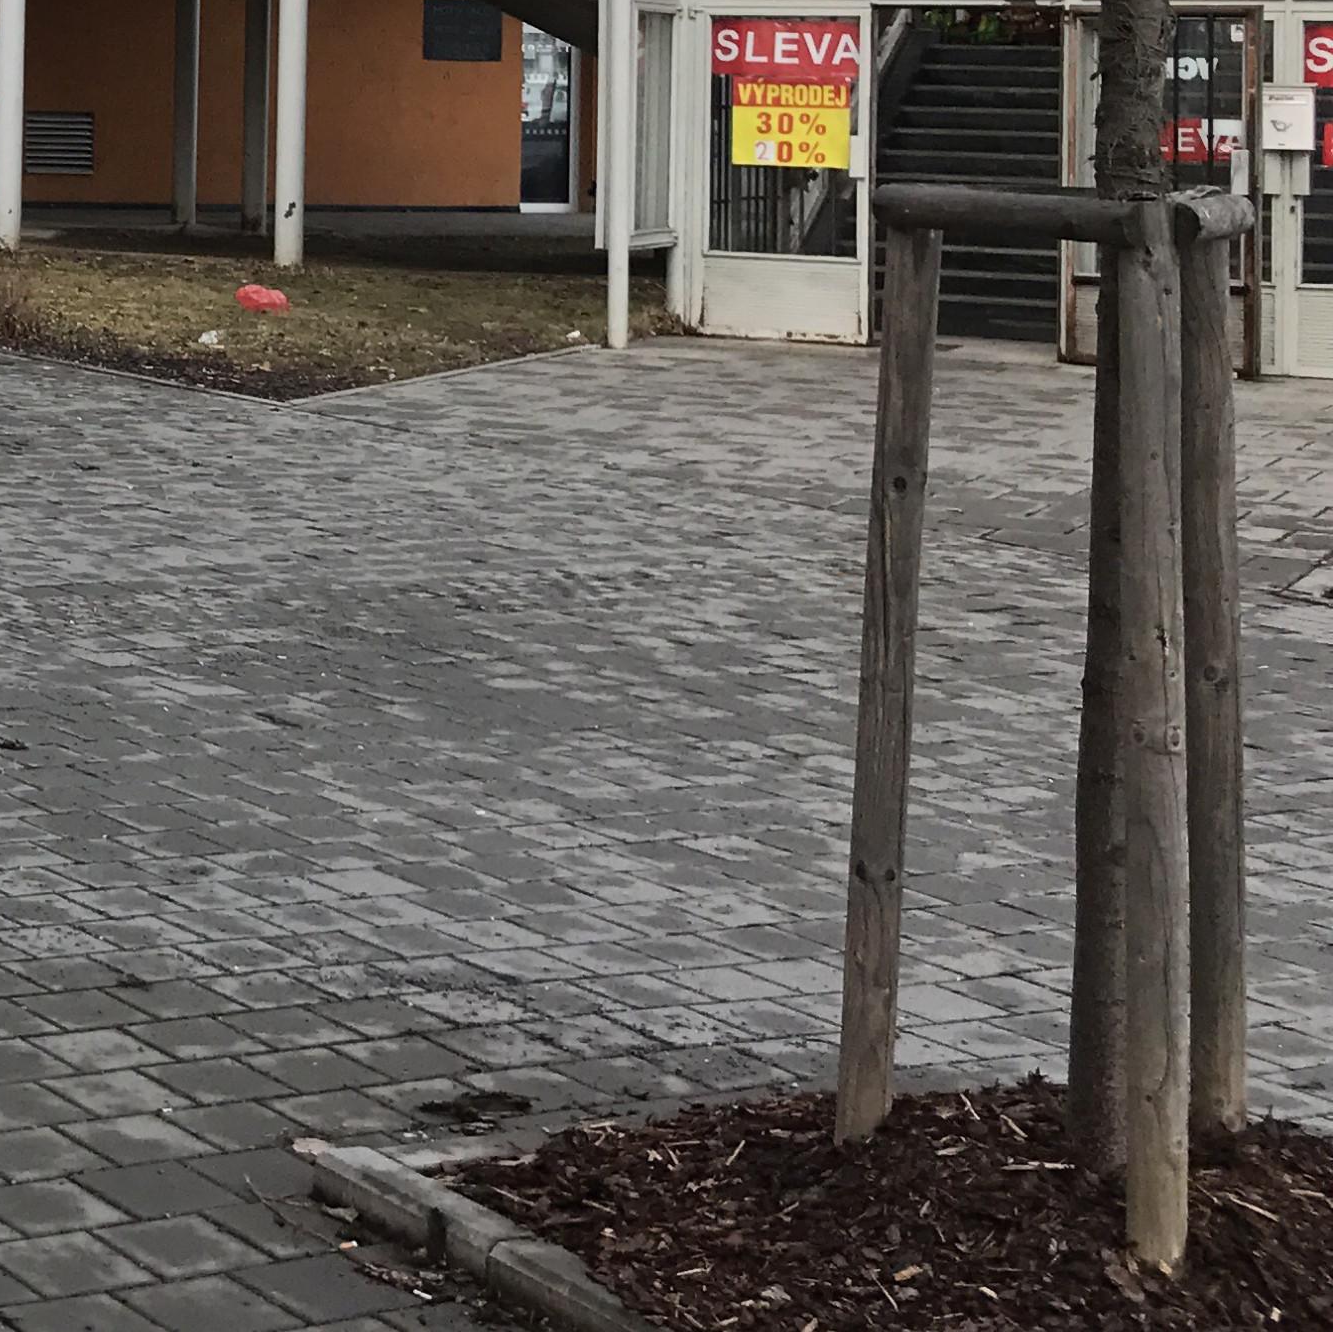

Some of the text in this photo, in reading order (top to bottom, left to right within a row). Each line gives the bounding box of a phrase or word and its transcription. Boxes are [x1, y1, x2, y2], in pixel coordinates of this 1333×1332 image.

[715, 29, 859, 65] SLEVA
[738, 78, 847, 107] VÝPRODEJ
[756, 111, 827, 135] 30%
